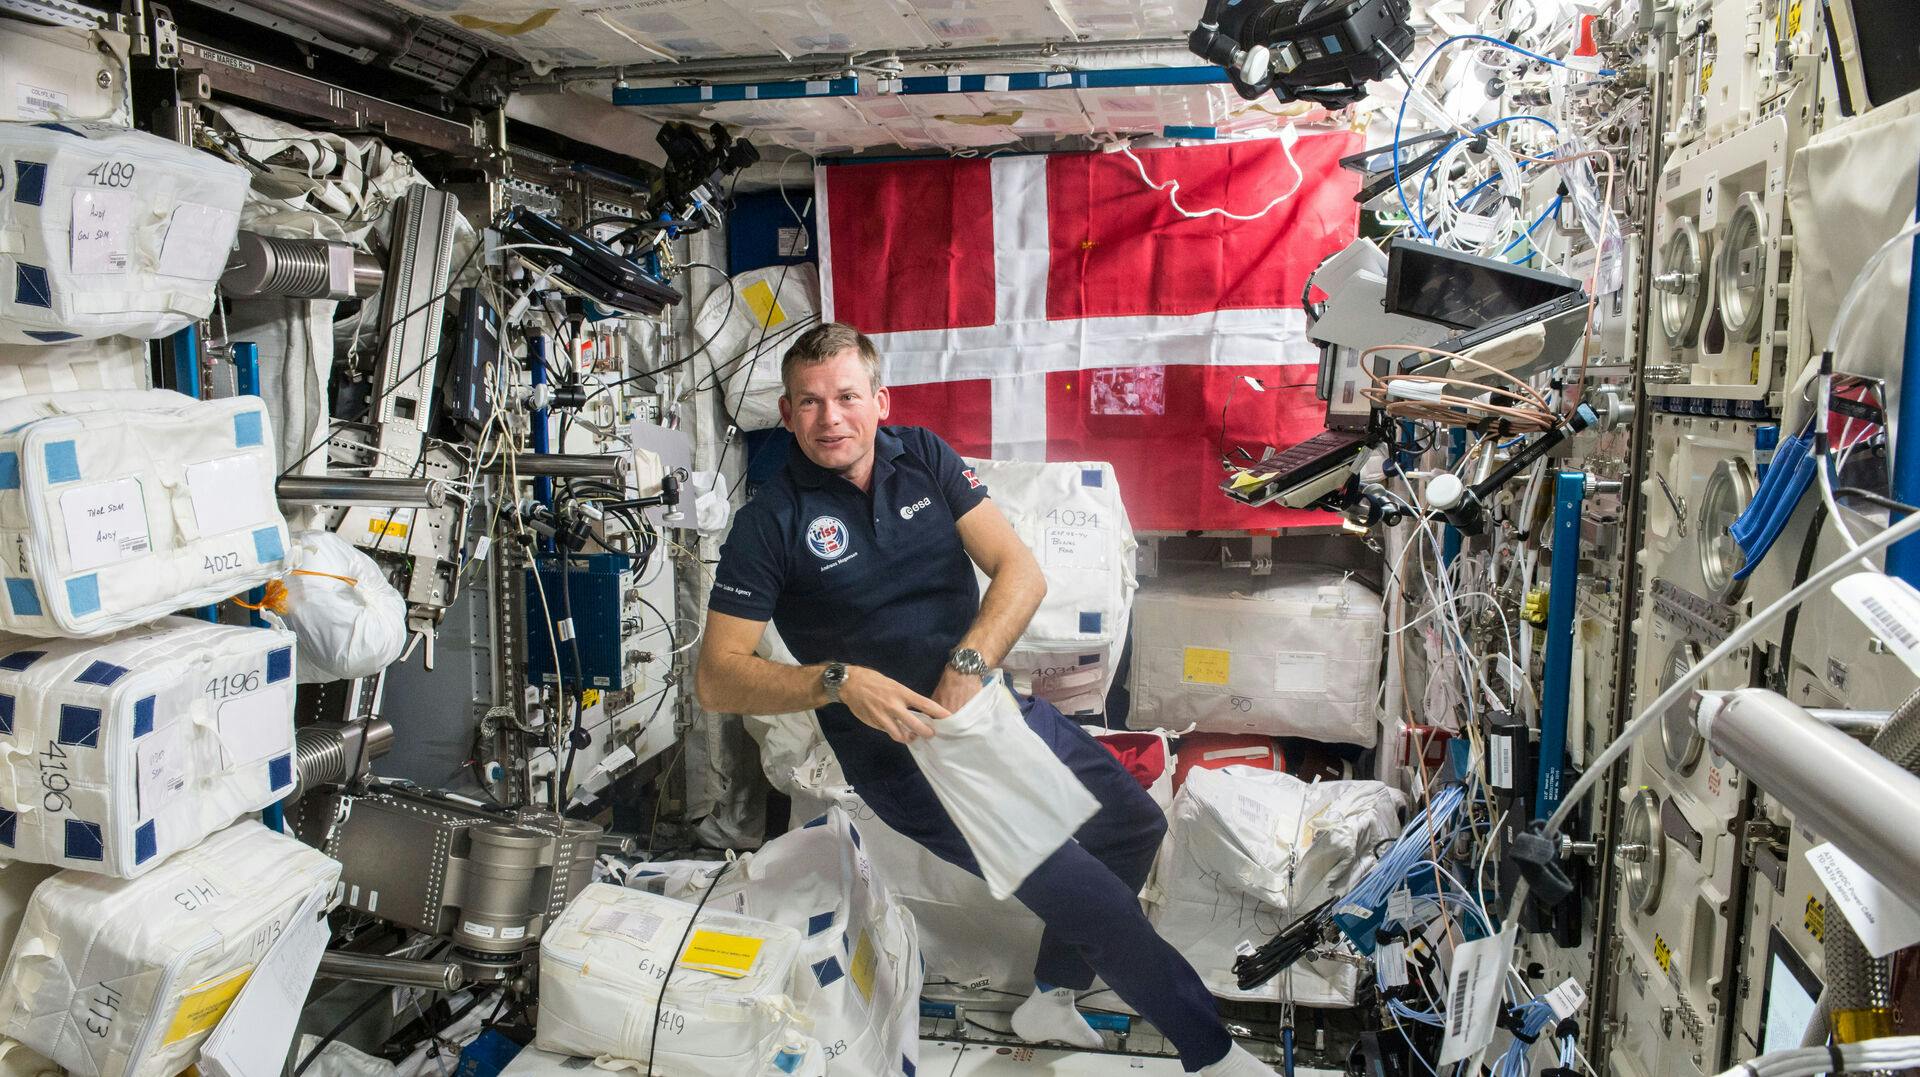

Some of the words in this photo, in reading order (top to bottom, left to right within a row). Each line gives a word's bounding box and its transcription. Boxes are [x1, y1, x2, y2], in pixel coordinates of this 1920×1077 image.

[203, 50, 216, 60] HRF
[216, 54, 238, 67] MARES
[239, 61, 252, 71] Rack
[88, 161, 135, 188] 4189
[1046, 508, 1101, 529] 4034
[203, 551, 242, 575] 4022
[1031, 665, 1077, 677] 4034
[205, 670, 260, 700] 4196
[1230, 696, 1253, 713] 90
[39, 740, 73, 813] 4196
[174, 878, 221, 912] 1413
[1848, 887, 1862, 906] Power
[1860, 906, 1875, 924] Cable
[250, 920, 282, 957] 1413
[970, 979, 990, 990] ZERO
[86, 981, 122, 1038] 1413
